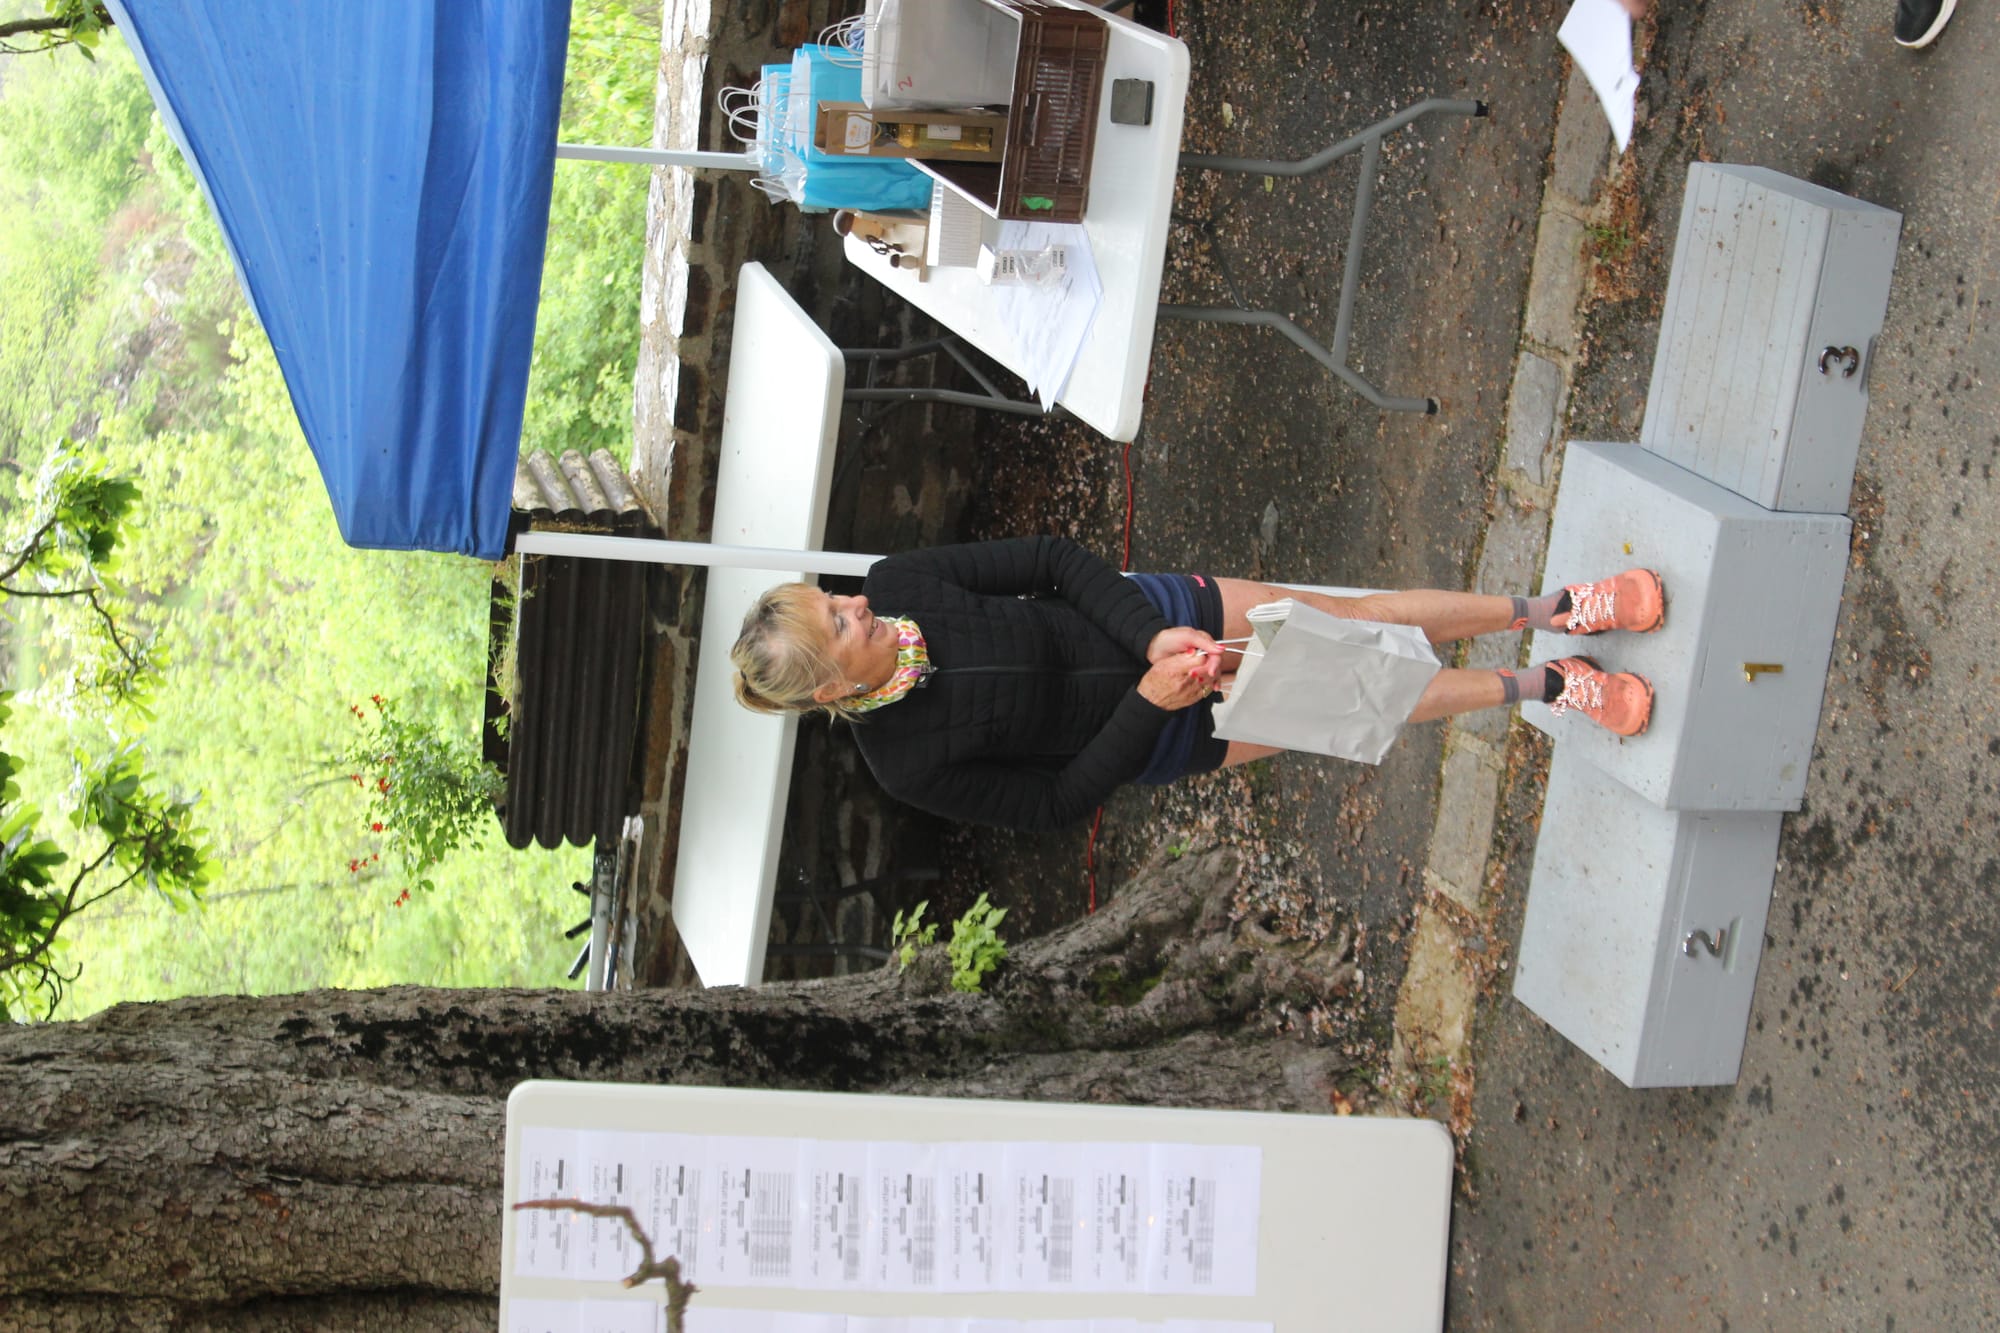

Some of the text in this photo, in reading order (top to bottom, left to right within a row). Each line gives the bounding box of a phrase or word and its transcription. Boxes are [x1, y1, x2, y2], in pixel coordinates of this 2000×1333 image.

[897, 75, 912, 91] 2
[1818, 346, 1859, 379] 3
[1743, 662, 1784, 682] 1
[1682, 929, 1726, 959] 2
